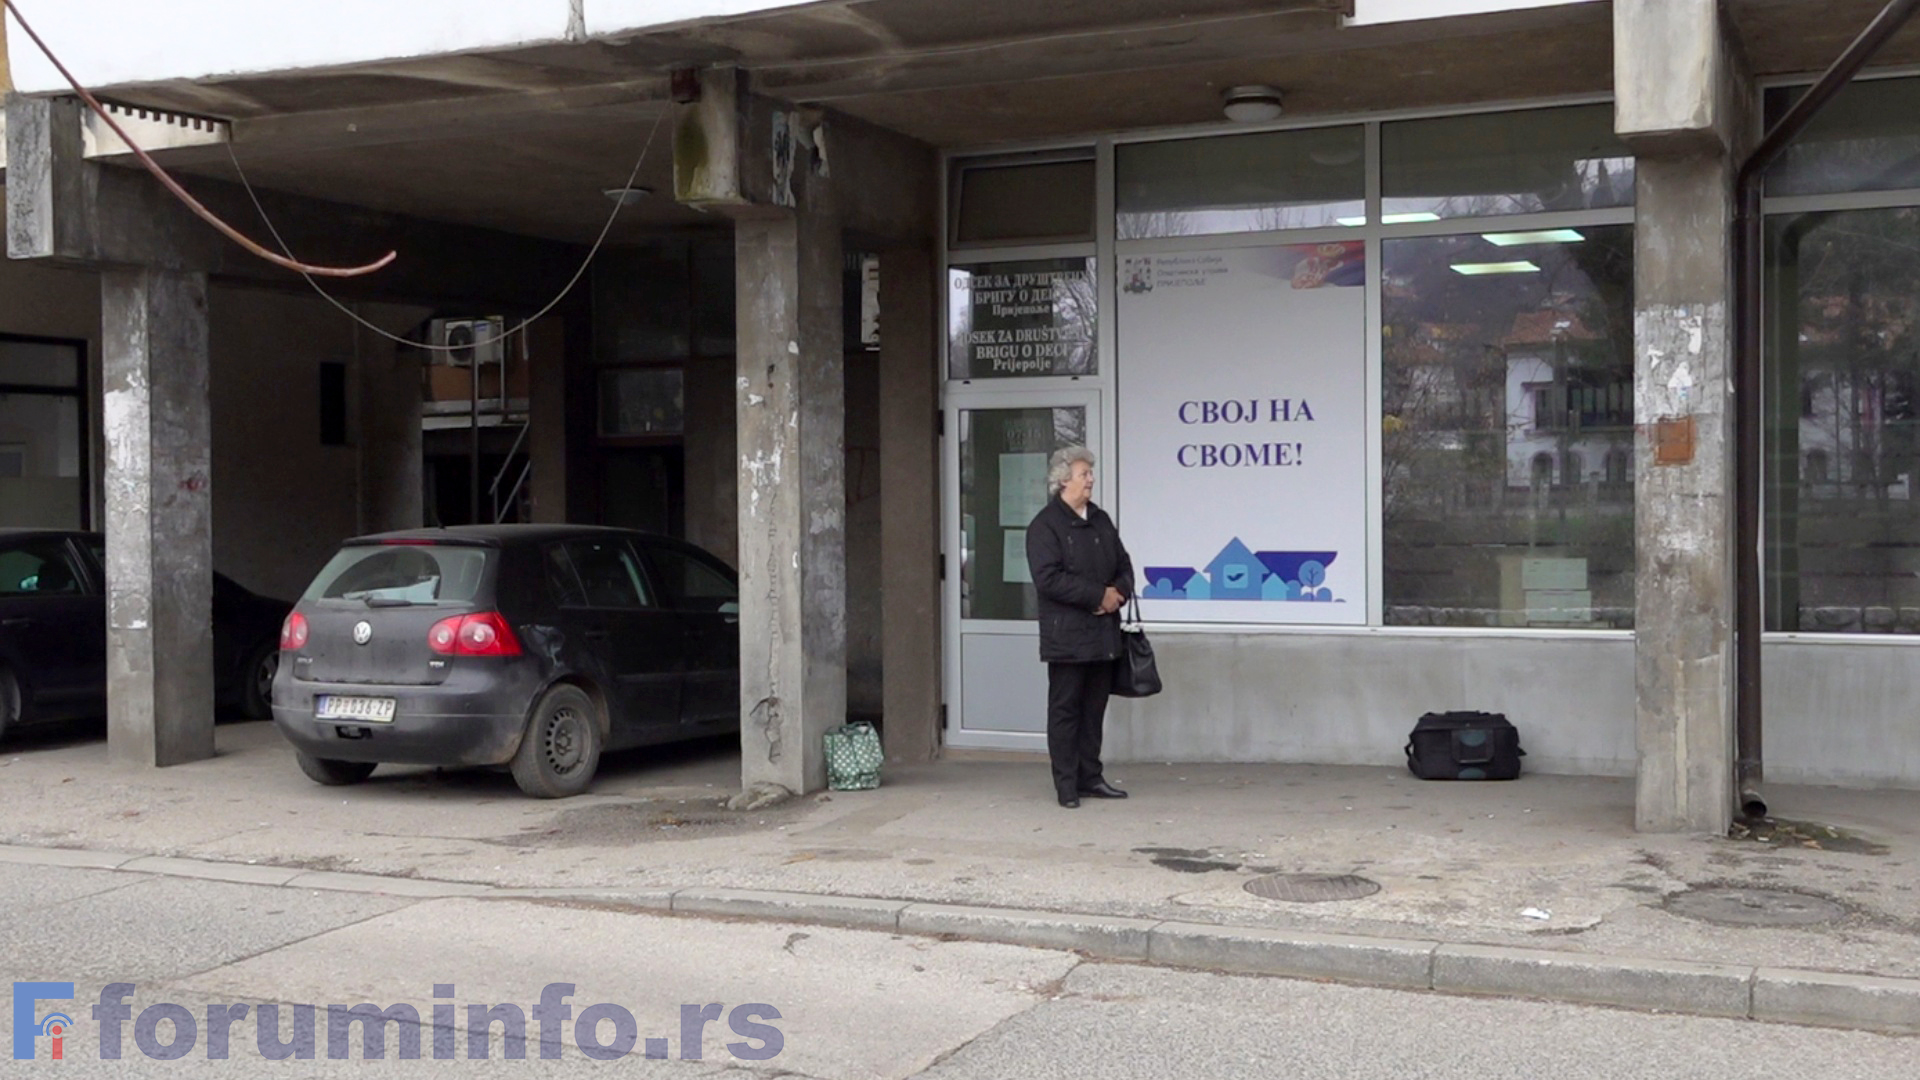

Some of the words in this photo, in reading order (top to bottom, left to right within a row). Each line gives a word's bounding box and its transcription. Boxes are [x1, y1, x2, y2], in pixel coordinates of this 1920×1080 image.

[994, 275, 1010, 288] ЗА
[975, 290, 1017, 304] БРИГУ
[1019, 290, 1029, 302] О
[955, 330, 995, 345] DSEK
[997, 329, 1013, 343] ZA
[976, 345, 1019, 360] BRIGU
[1021, 345, 1032, 358] O
[1035, 343, 1068, 357] DECI
[993, 357, 1051, 372] Prijepolje
[1178, 399, 1259, 424] СВОЈ
[1269, 398, 1315, 422] НА
[1177, 443, 1303, 468] СВОМЕ!
